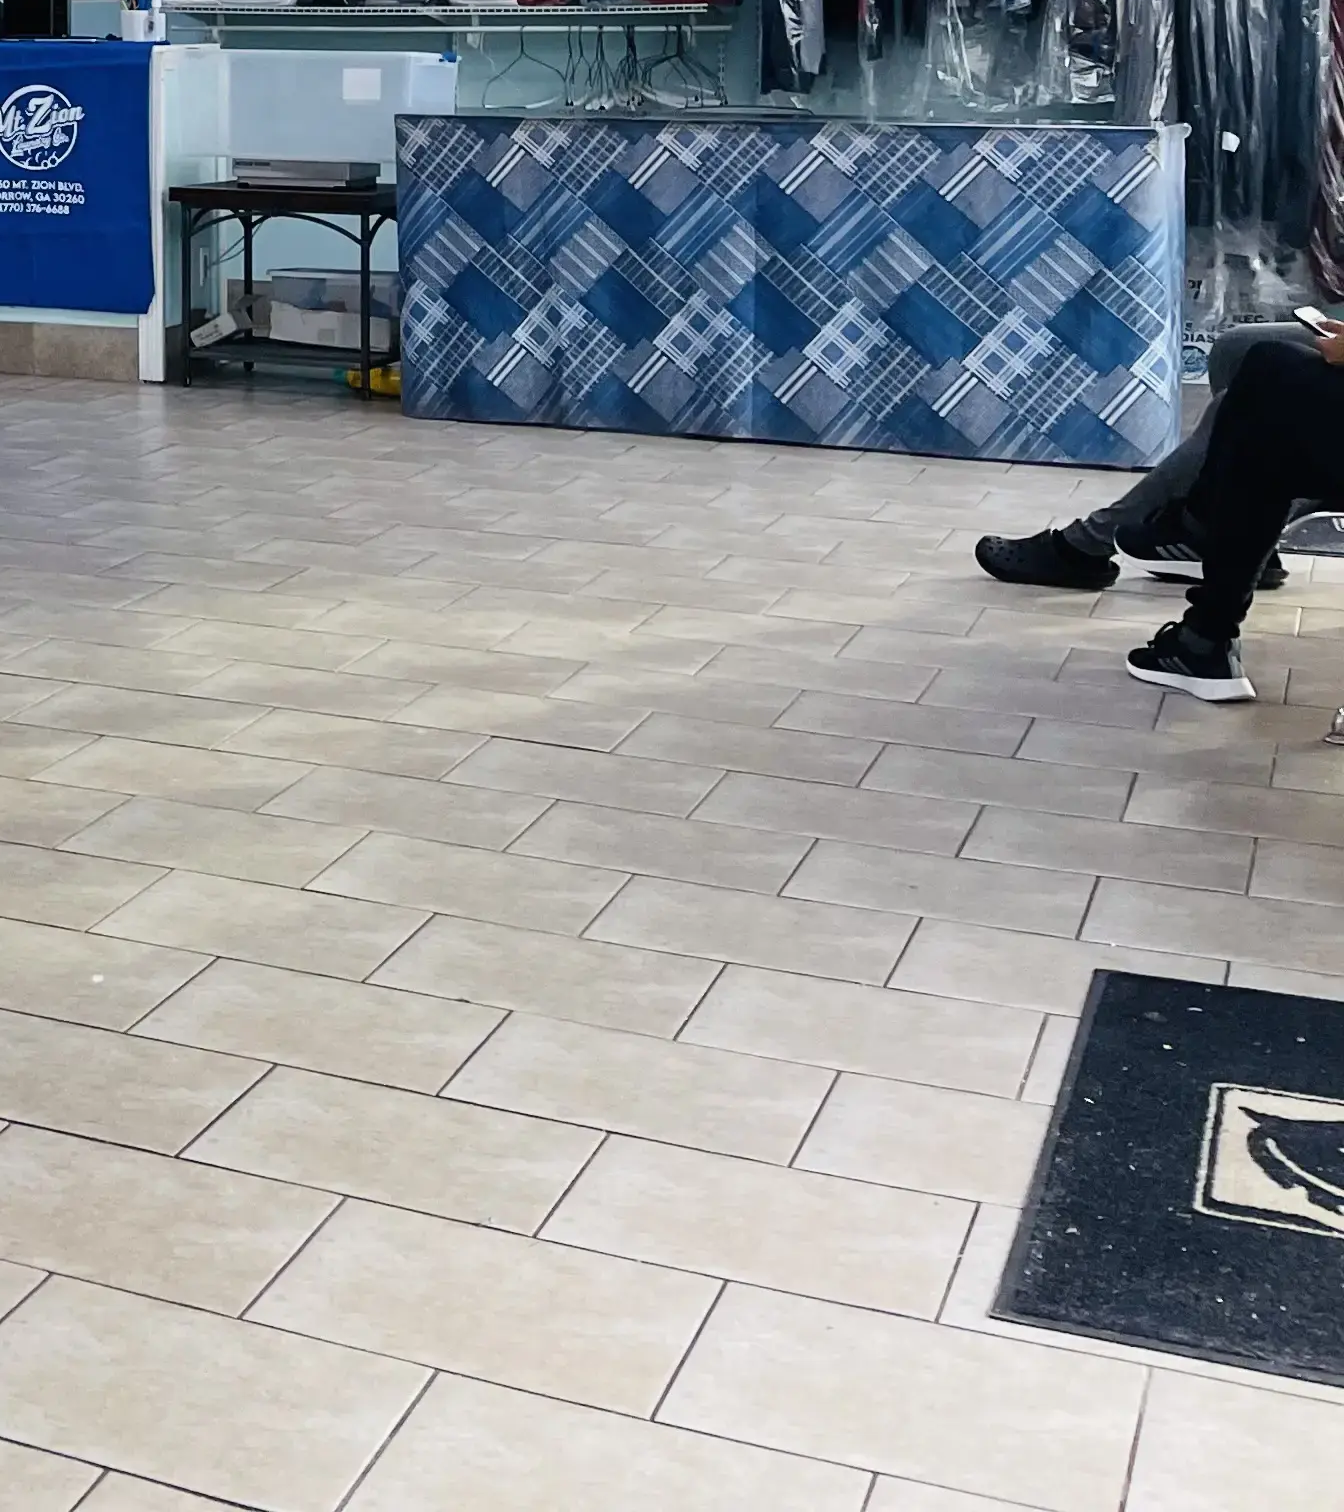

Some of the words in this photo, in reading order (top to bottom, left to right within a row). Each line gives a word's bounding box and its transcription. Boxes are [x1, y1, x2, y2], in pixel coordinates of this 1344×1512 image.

[25, 93, 86, 136] Zion
[31, 180, 56, 190] ZION
[35, 191, 51, 202] GA
